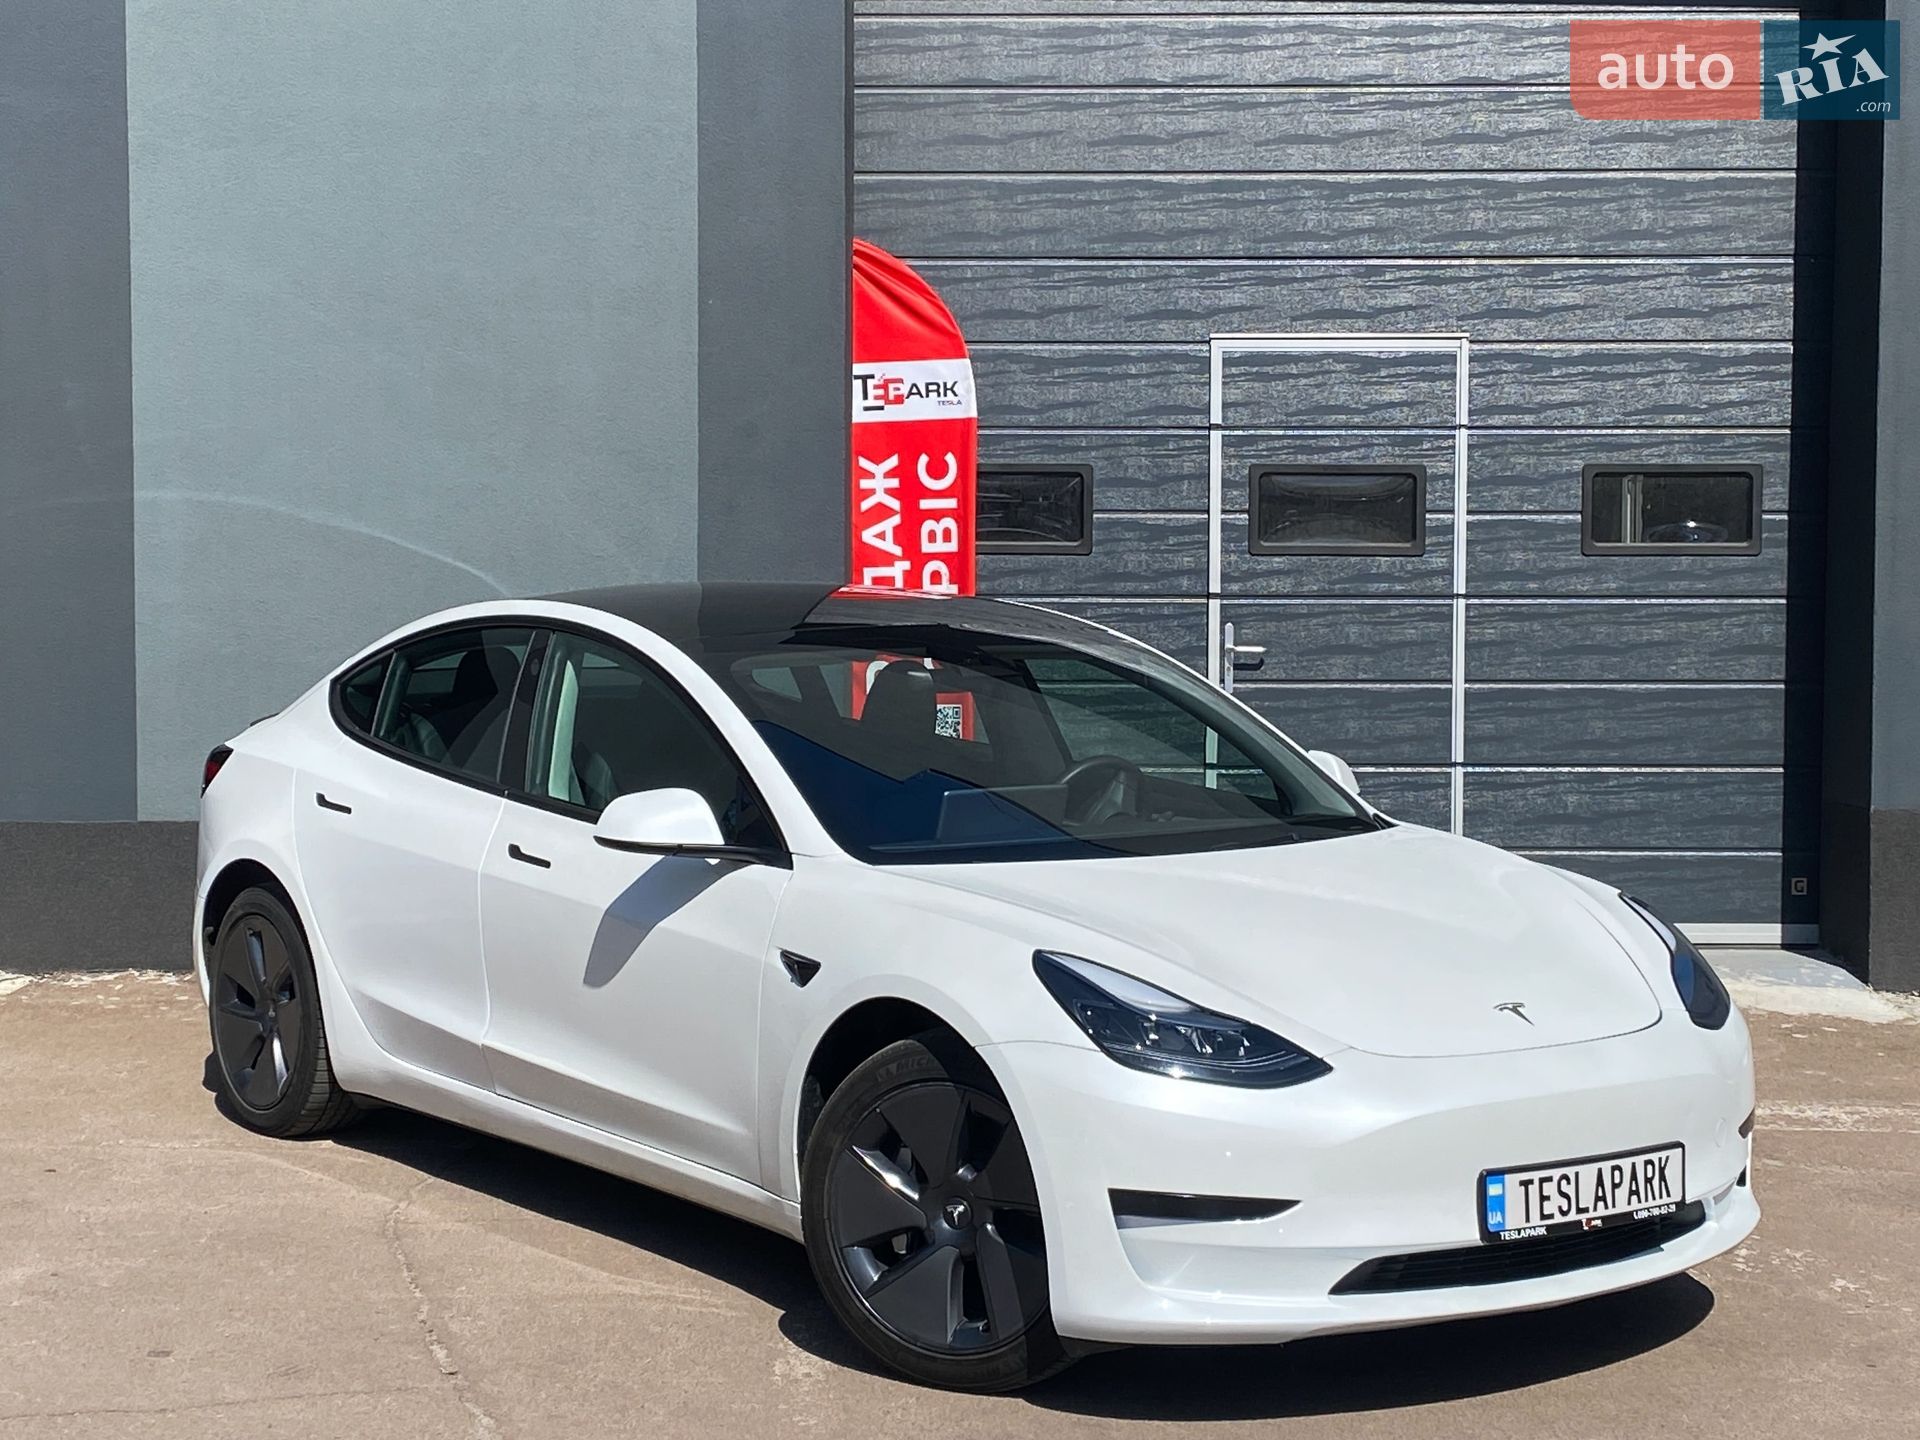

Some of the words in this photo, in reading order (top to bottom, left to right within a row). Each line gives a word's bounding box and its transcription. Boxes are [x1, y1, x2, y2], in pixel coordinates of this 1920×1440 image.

[937, 399, 963, 407] TESLA
[1519, 1156, 1671, 1223] TESLAPARK
[1488, 1211, 1503, 1225] UA
[1500, 1225, 1547, 1240] TESLAPARK
